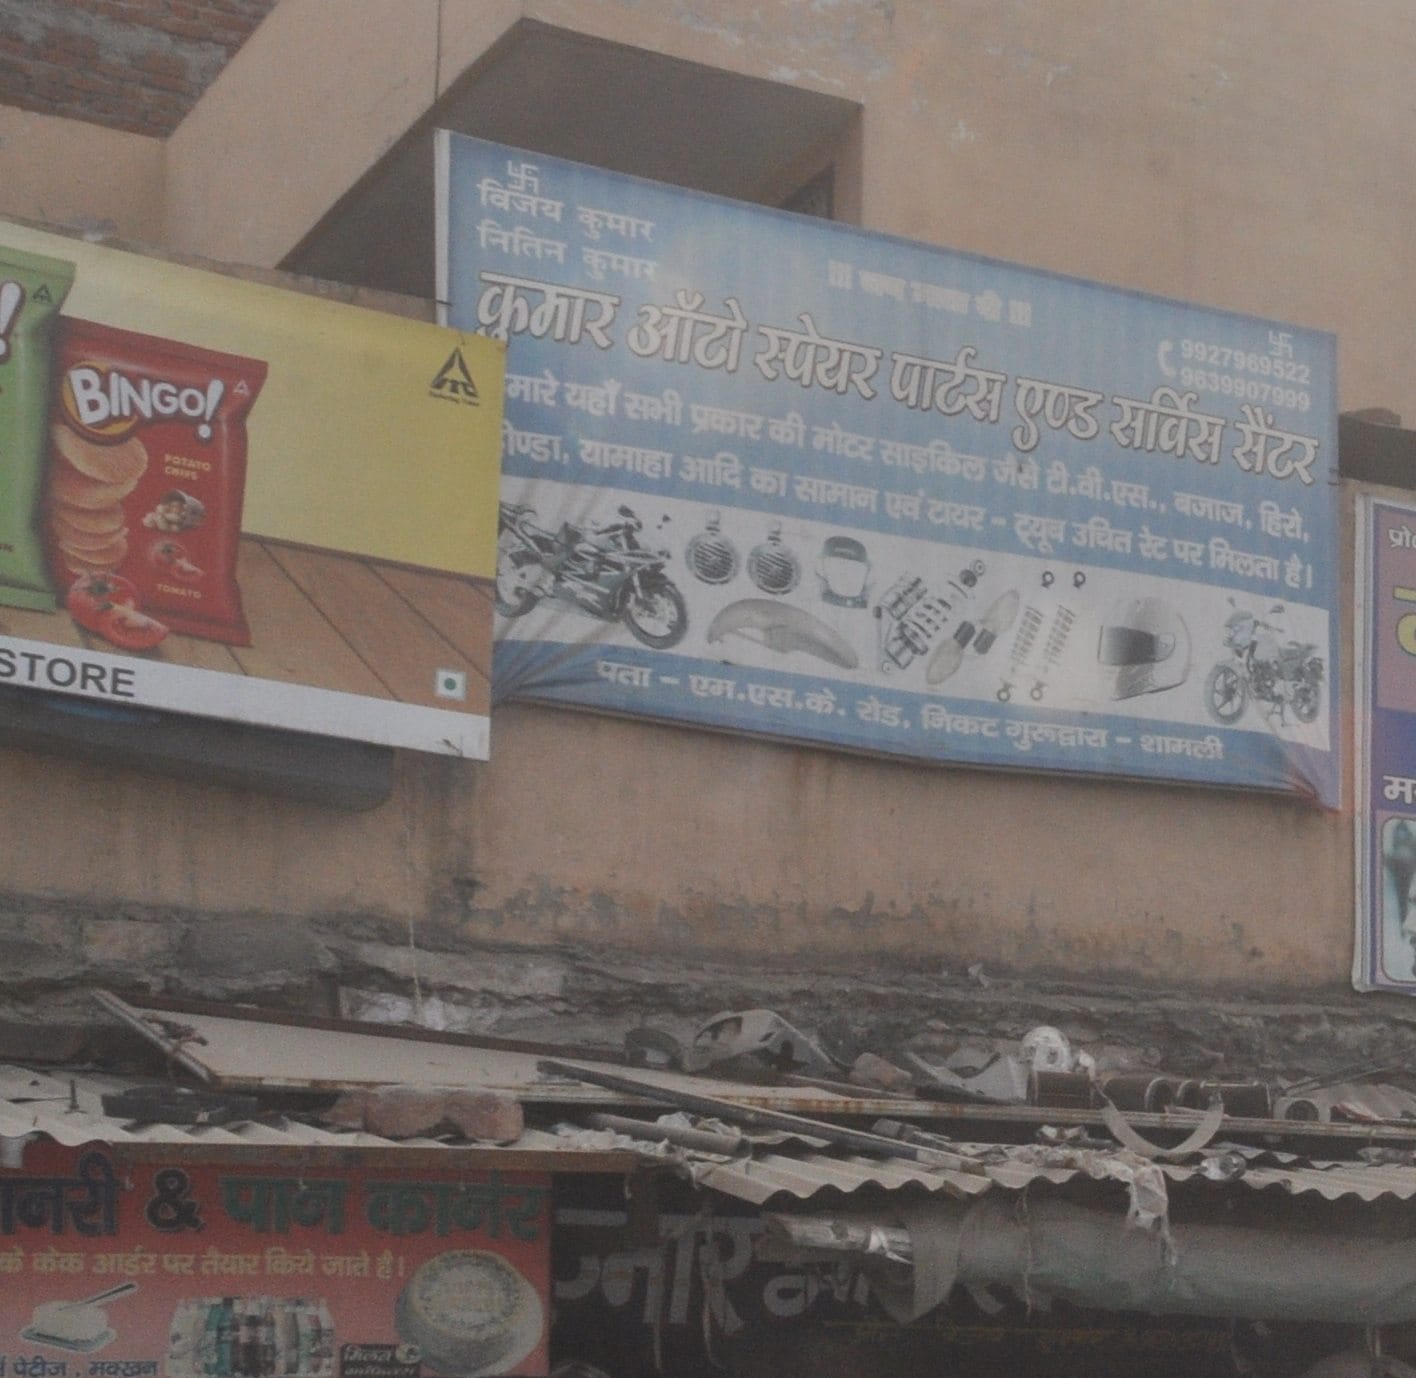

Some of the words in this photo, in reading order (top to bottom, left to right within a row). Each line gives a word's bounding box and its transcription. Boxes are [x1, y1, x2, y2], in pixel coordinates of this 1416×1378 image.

[477, 177, 563, 221] विजय
[576, 204, 656, 242] कुमार
[476, 221, 567, 264] नितिन
[581, 248, 659, 283] कुमार
[69, 367, 225, 439] BINGO!
[627, 288, 748, 373] ऑटो
[754, 312, 883, 399] स्पेयर
[1010, 375, 1104, 452] एण्ड
[1109, 385, 1226, 465] सर्विस
[504, 369, 560, 407] मारे
[623, 389, 683, 426] सभी
[688, 404, 765, 441] प्रकार
[767, 410, 806, 447] की
[811, 421, 876, 461] मोटर
[577, 438, 674, 478] यामाहा
[678, 451, 743, 489] आदि
[750, 466, 788, 497] का
[794, 475, 879, 513] सामान
[1071, 516, 1134, 554] उचित
[1138, 525, 1169, 561] रेट
[1173, 538, 1205, 567] पर
[1208, 536, 1280, 581] मिलता
[0, 648, 137, 699] STORE
[921, 703, 1000, 738] निकट
[1140, 734, 1225, 760] शामली
[217, 1175, 348, 1237] पान
[162, 1252, 196, 1275] पर
